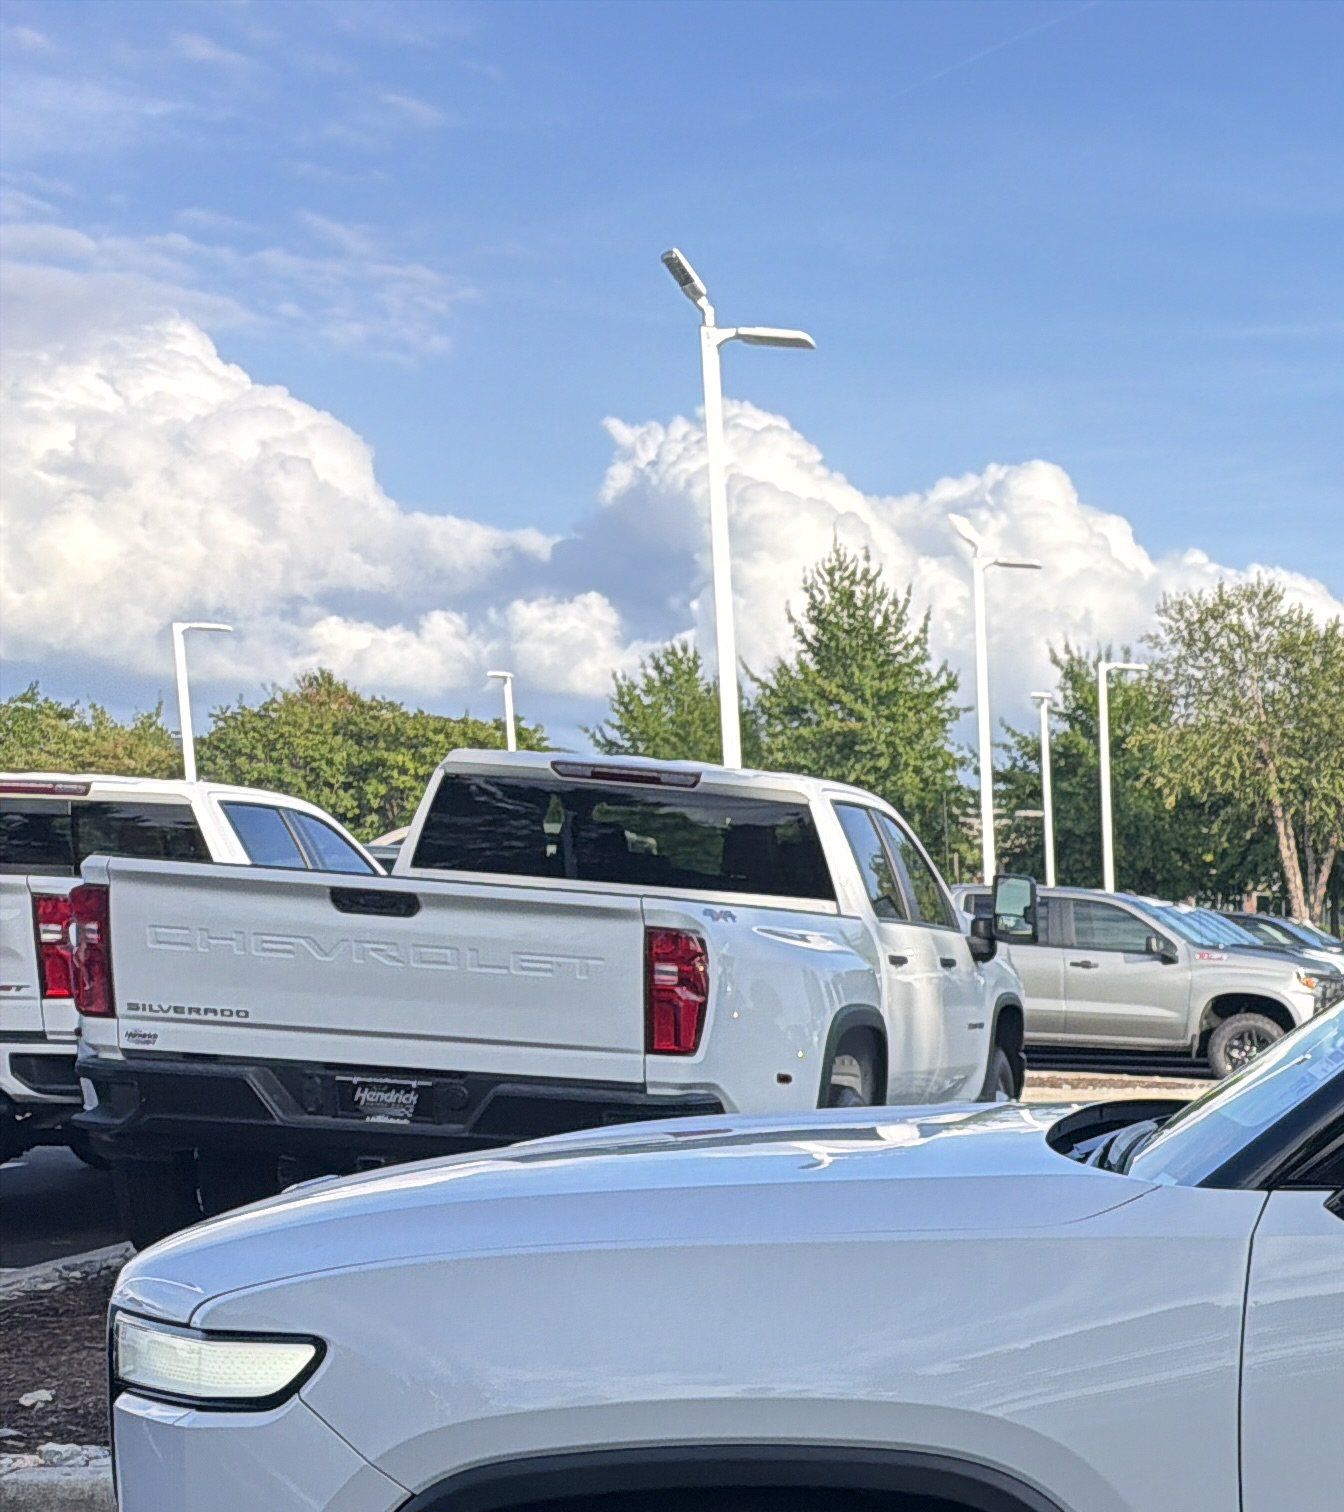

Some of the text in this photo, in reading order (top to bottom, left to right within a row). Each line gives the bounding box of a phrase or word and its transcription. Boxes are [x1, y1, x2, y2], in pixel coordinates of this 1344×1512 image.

[145, 924, 605, 980] CHEVROLET
[126, 1002, 250, 1019] SILVERADO
[353, 1087, 419, 1106] Hendrick
